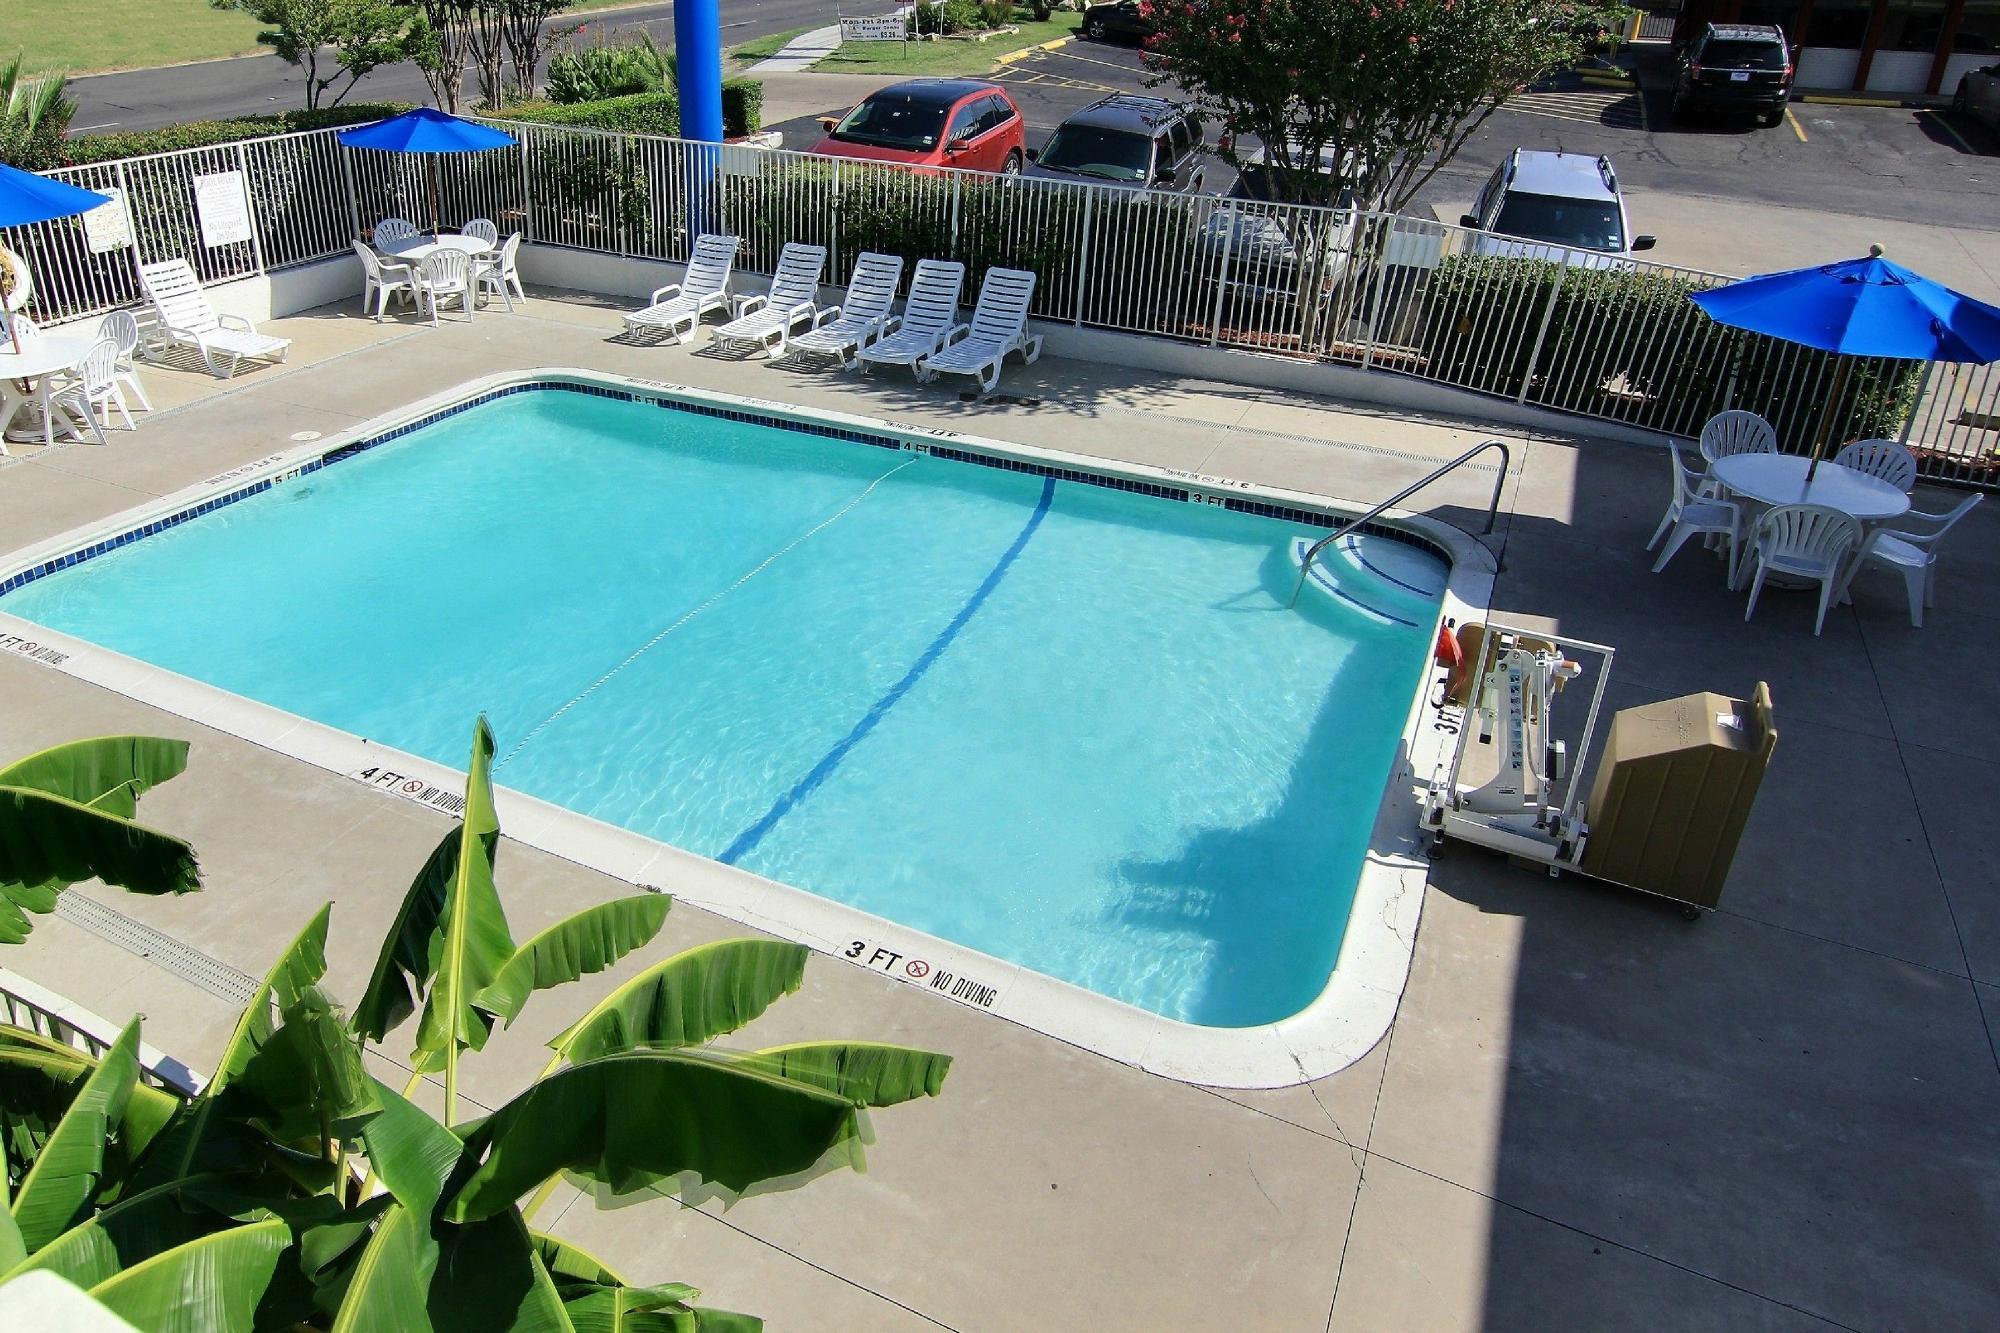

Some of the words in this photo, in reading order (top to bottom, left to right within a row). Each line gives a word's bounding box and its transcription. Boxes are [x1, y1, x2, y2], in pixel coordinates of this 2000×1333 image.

[903, 442, 911, 451] 4
[916, 444, 929, 453] FT
[275, 475, 283, 485] 5
[286, 468, 300, 480] FT
[1193, 493, 1203, 503] 3
[1207, 495, 1225, 507] FT
[360, 767, 380, 779] 4
[375, 772, 405, 788] FT
[416, 787, 440, 801] NO
[432, 791, 467, 813] DIVING
[845, 941, 866, 958] 3
[868, 947, 903, 971] FT
[929, 970, 953, 991] NO
[950, 977, 998, 1008] DIVING
